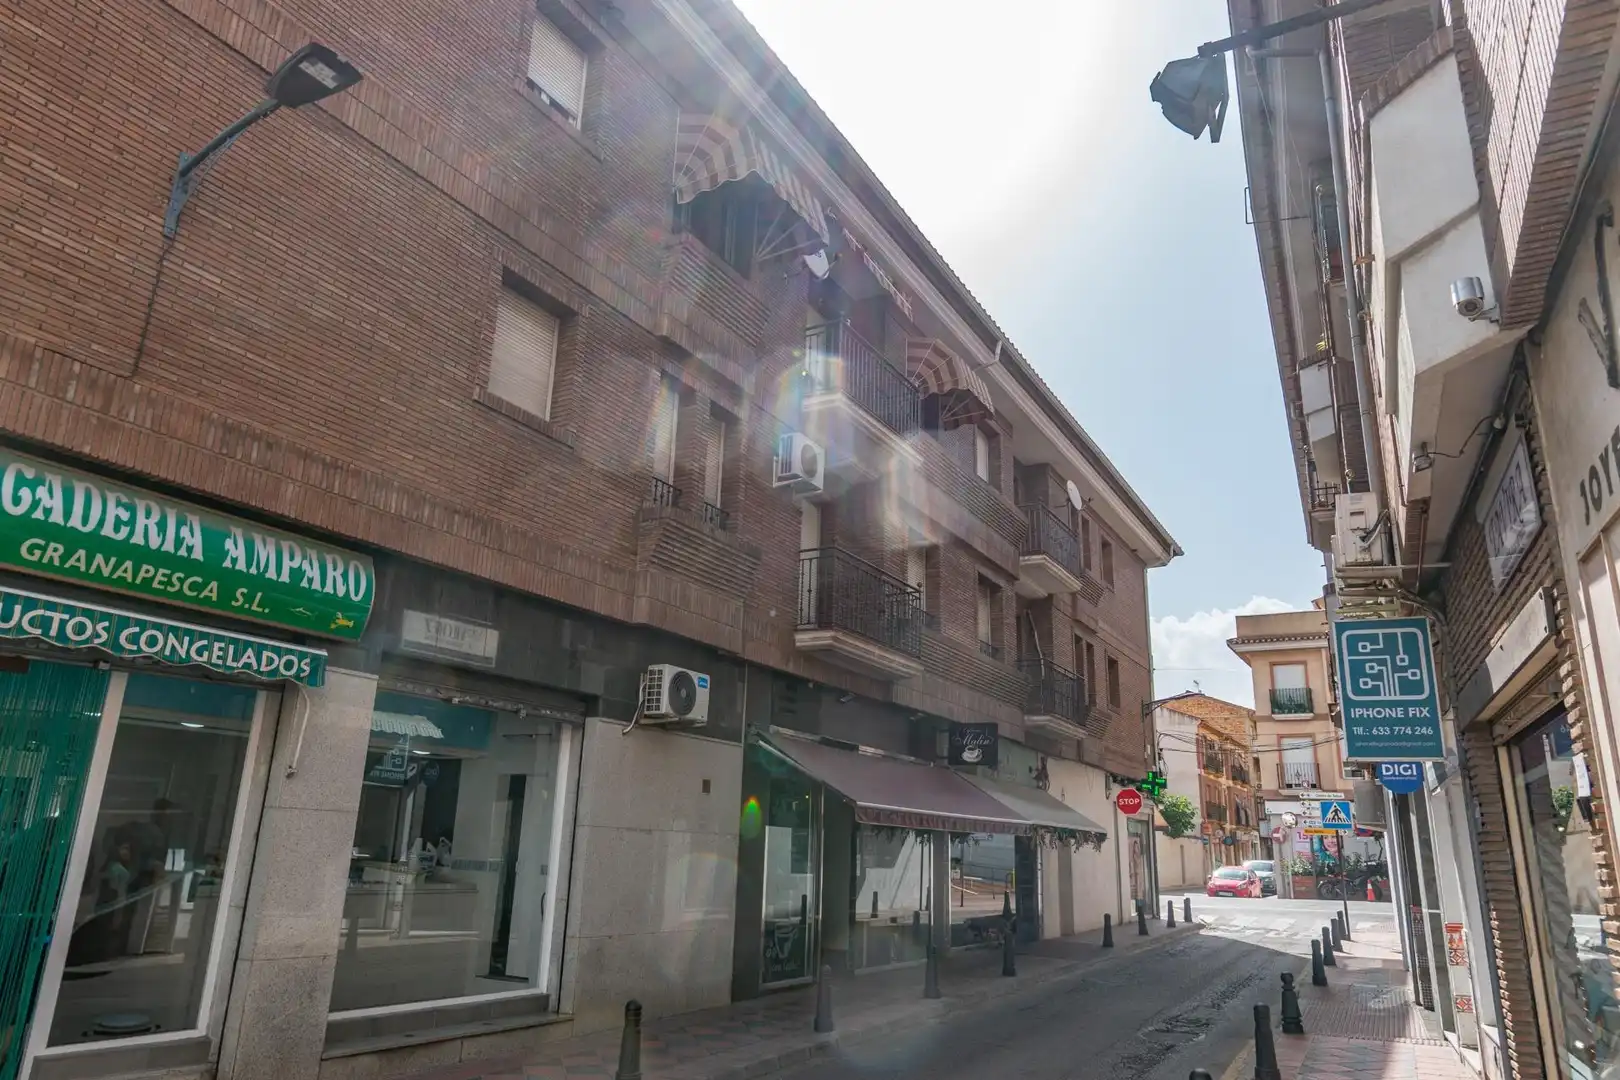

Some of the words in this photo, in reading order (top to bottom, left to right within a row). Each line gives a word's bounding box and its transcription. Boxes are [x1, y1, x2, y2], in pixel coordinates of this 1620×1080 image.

[223, 526, 367, 602] AMPARO
[20, 538, 218, 603] GRANAPESCA
[232, 587, 270, 614] S.L.
[0, 602, 109, 644] UCTOS
[119, 627, 311, 678] CONGELADOS
[1351, 707, 1404, 718] IPHONE
[1408, 707, 1430, 718] FIX
[1372, 726, 1390, 735] 633
[1393, 726, 1411, 735] 774
[1415, 726, 1433, 735] 246
[1381, 763, 1417, 776] DIGI
[1119, 798, 1140, 806] STOP
